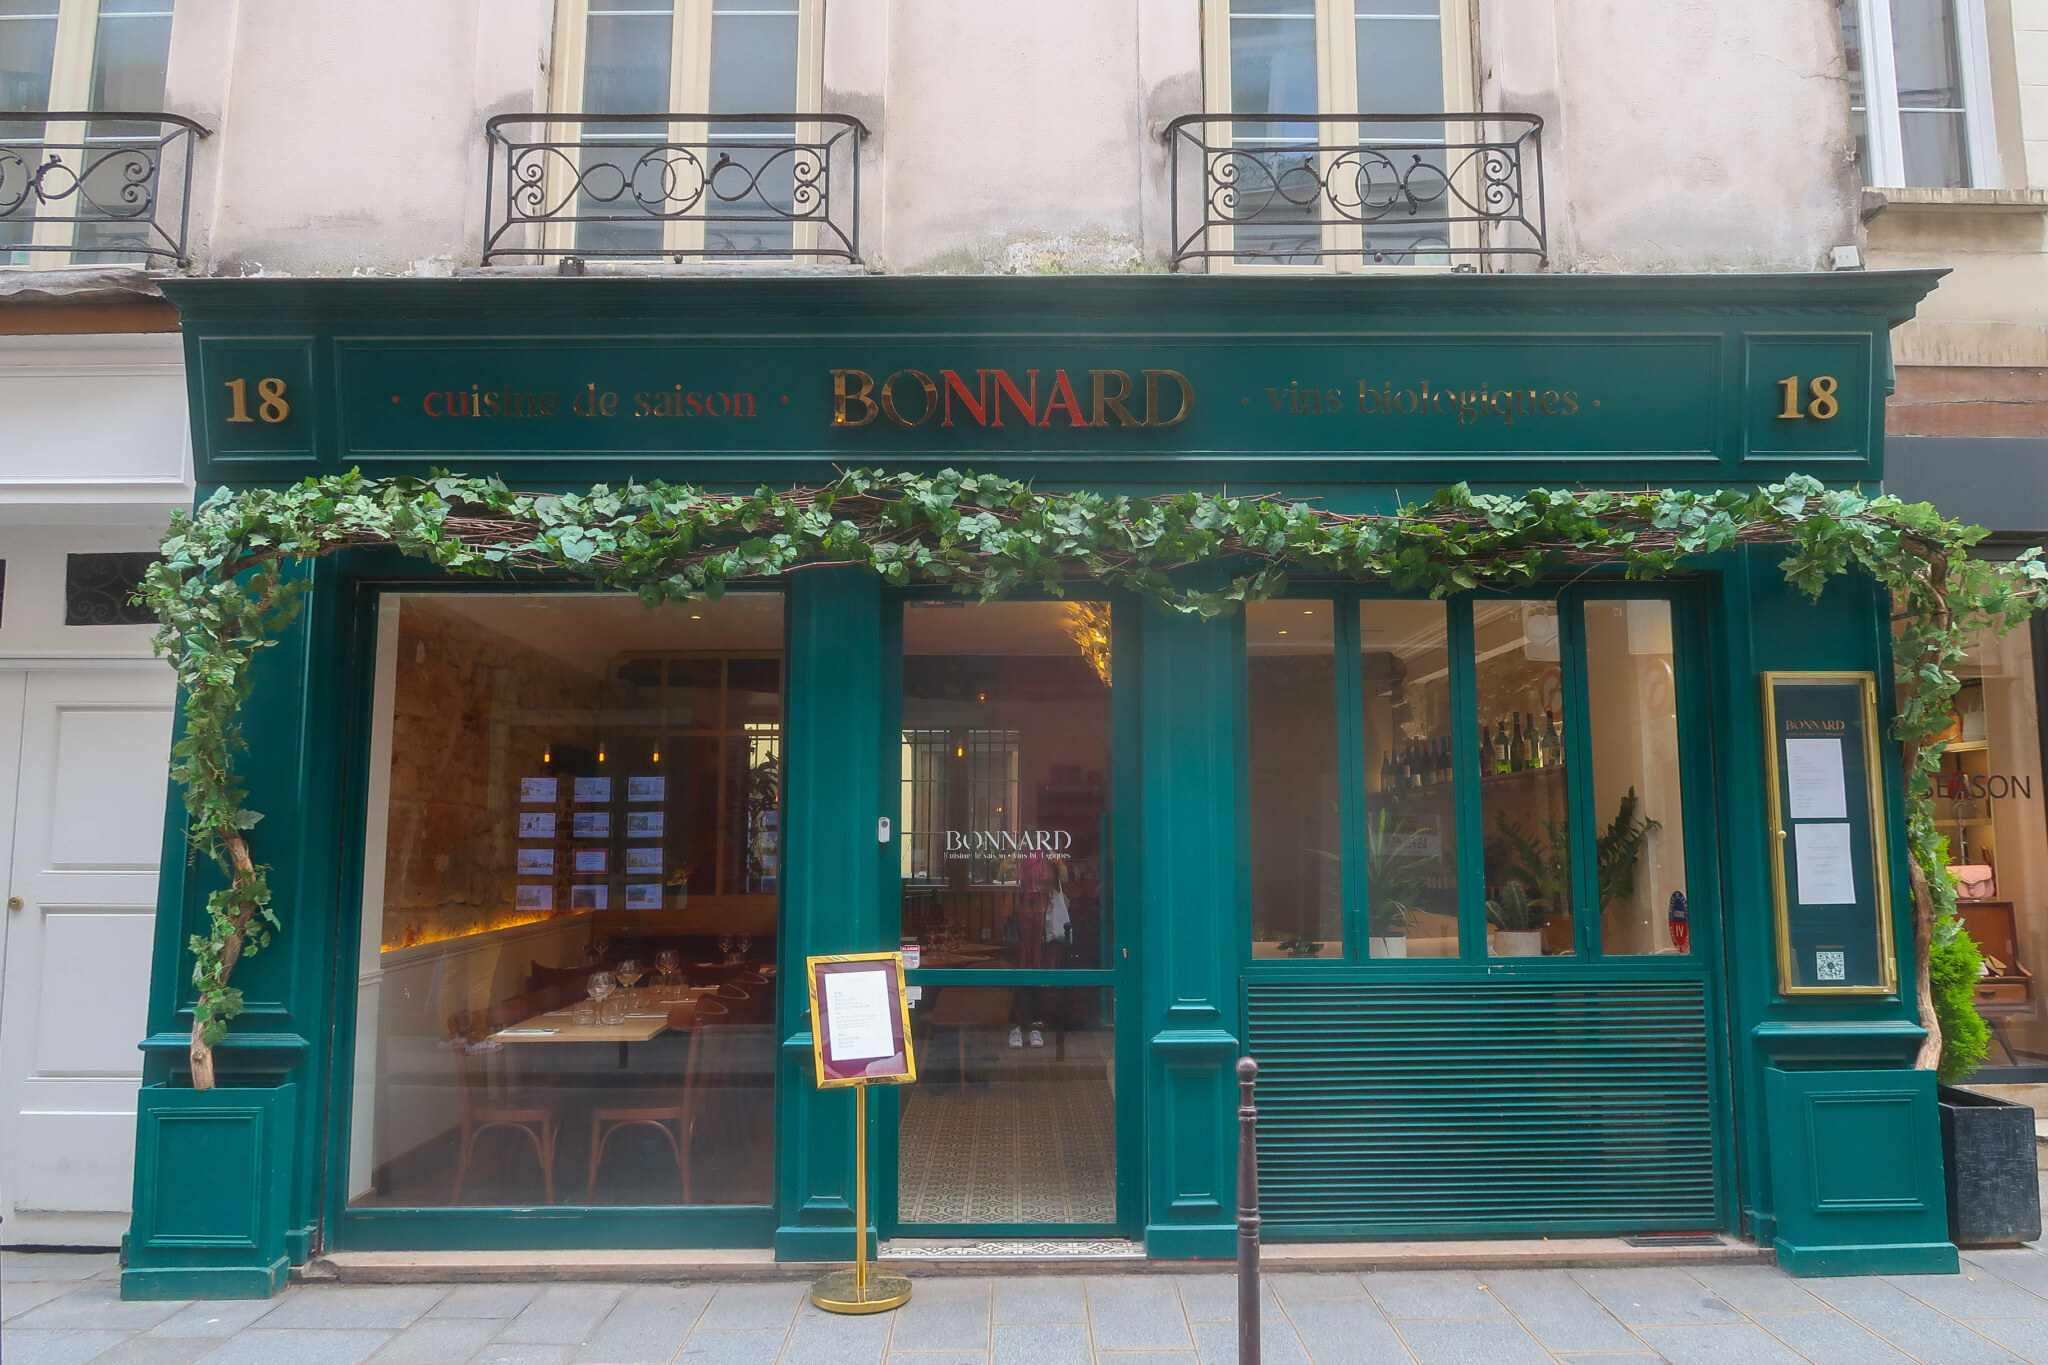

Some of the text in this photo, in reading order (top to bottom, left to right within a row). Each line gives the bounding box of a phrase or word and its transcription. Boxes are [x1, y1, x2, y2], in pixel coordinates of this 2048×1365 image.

[224, 377, 291, 423] 18
[423, 382, 757, 418] cuisine de saison
[829, 368, 1195, 428] BONNARD
[1264, 379, 1579, 426] vins biologiques
[1776, 374, 1839, 420] 18
[1785, 719, 1846, 731] BONNARD
[945, 830, 1072, 851] BONNARD
[1029, 851, 1071, 861] bilgiques
[1675, 924, 1684, 938] IV
